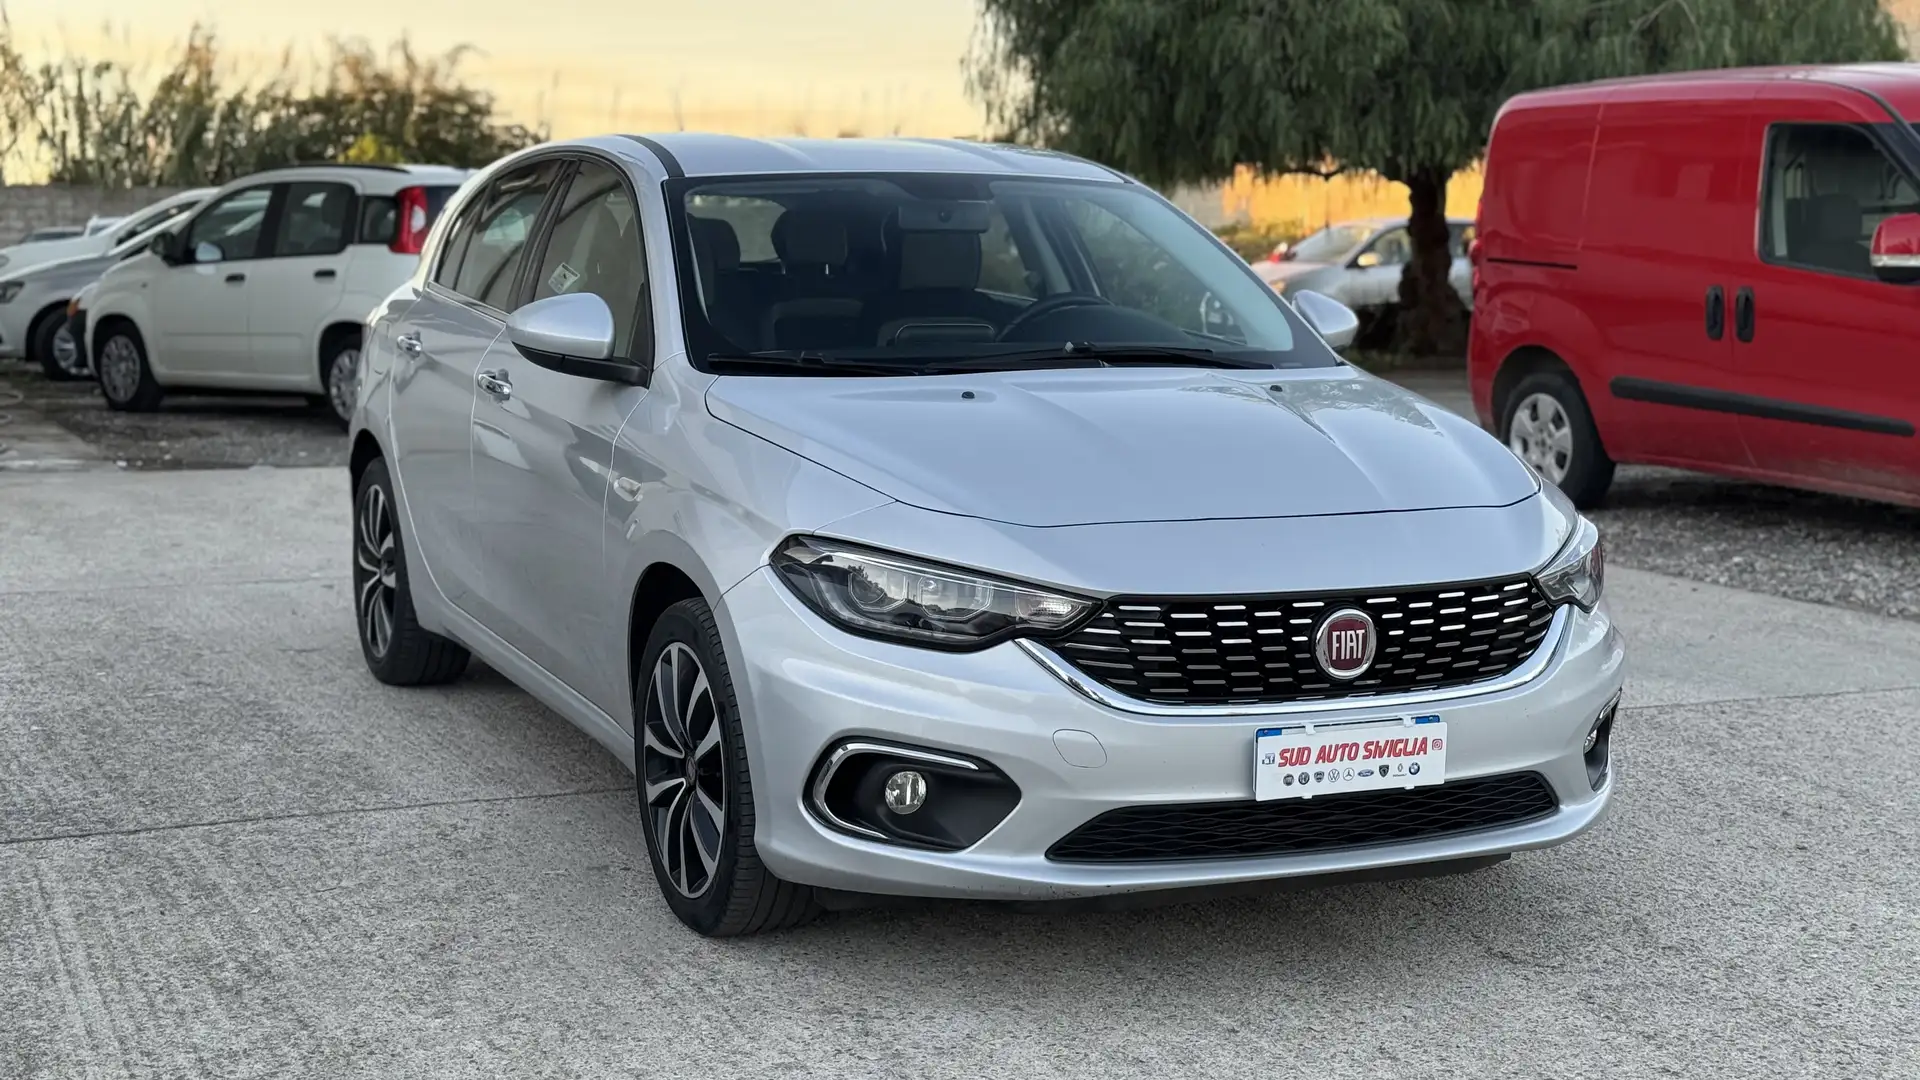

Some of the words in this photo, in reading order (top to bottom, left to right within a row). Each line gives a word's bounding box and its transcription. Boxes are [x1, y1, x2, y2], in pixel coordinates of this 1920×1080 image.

[1332, 629, 1365, 660] FIAT
[1278, 746, 1311, 767] SUD
[1315, 742, 1359, 764] AUTO
[1362, 737, 1428, 760] SIVIGLIA
